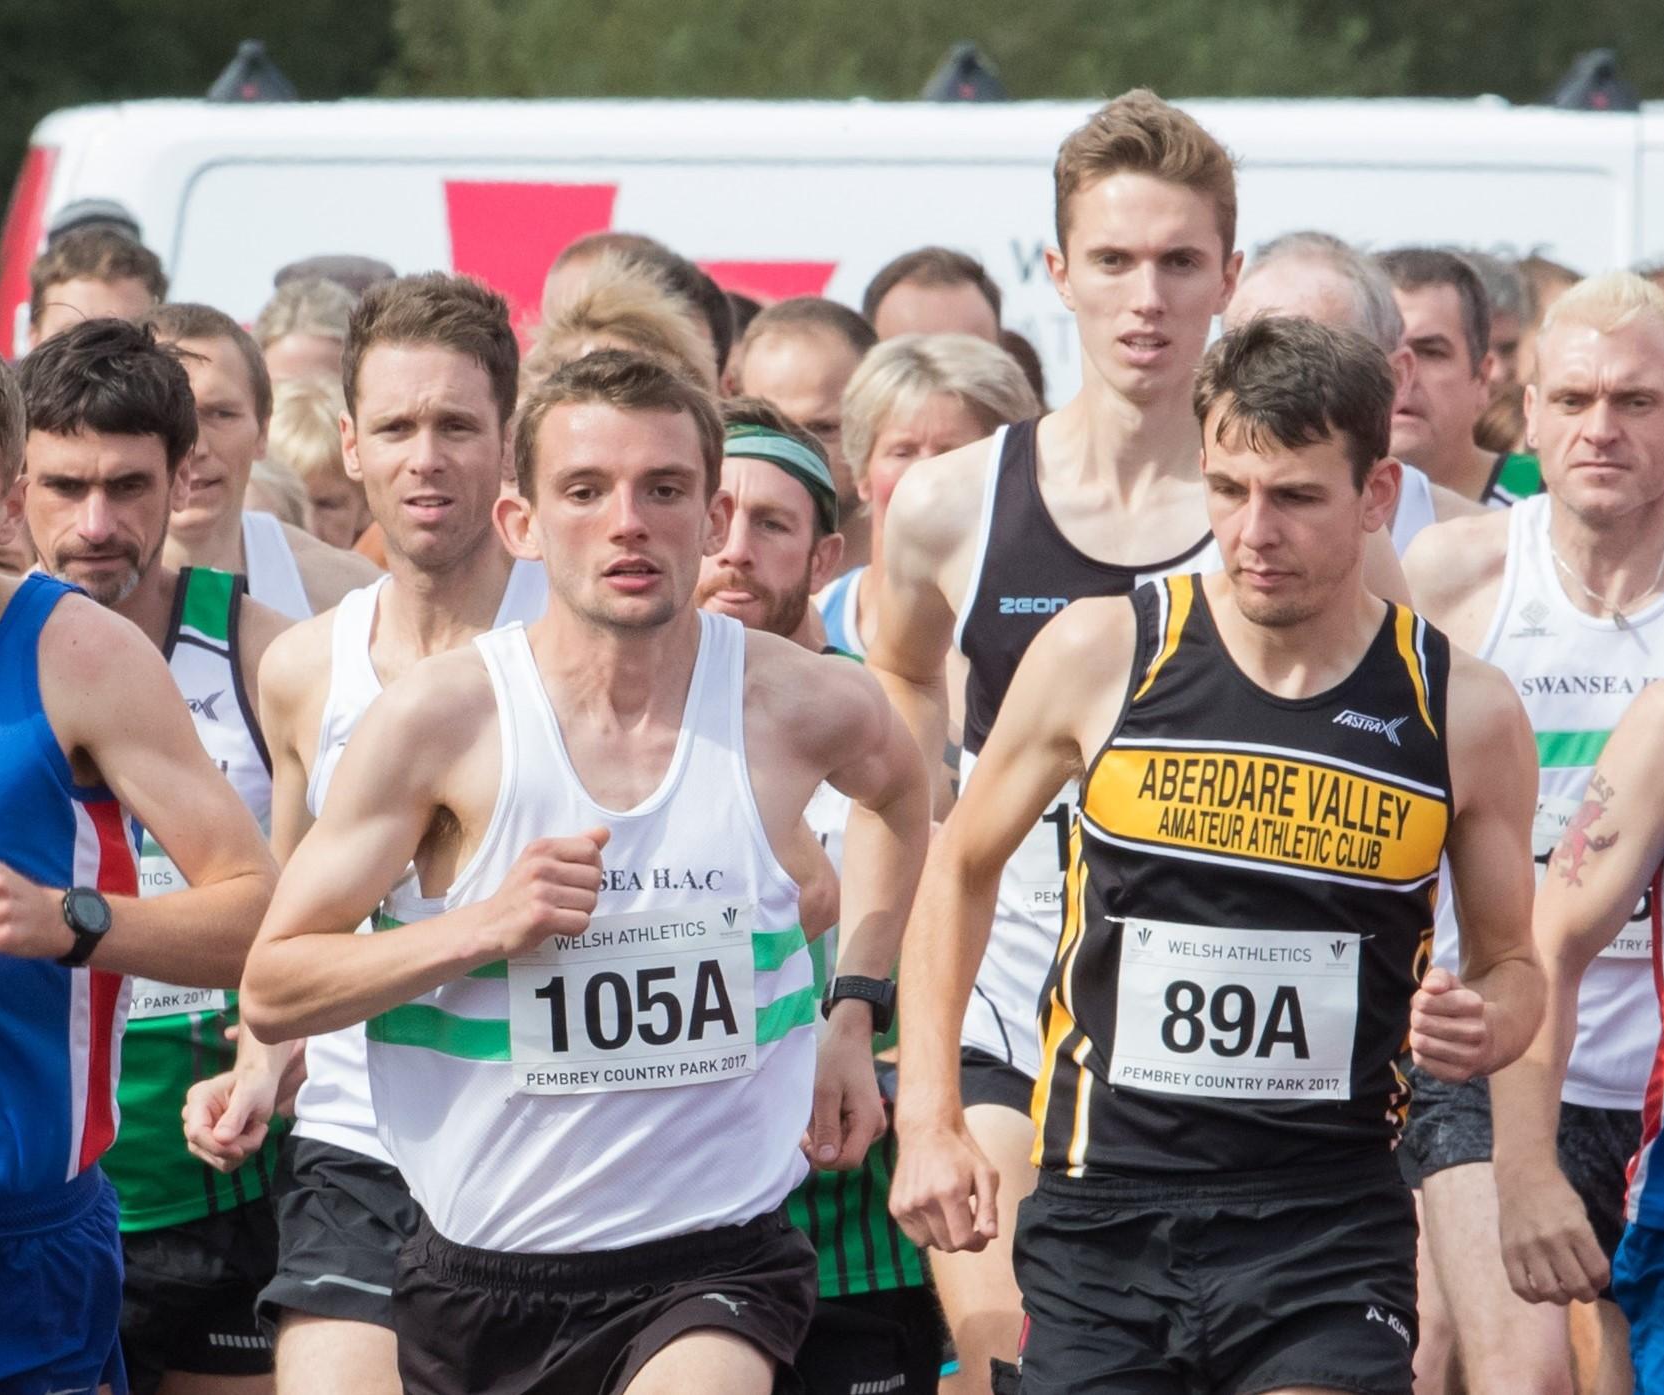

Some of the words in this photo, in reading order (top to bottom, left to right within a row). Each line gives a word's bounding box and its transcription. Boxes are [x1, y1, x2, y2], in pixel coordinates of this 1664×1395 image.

[1521, 676, 1633, 696] SWANSEA
[1138, 758, 1299, 818] ABERDARE
[1307, 770, 1411, 841] VALLEY
[1158, 807, 1244, 847] AMATEUR
[1246, 818, 1331, 864] ATHLETIC
[1335, 837, 1382, 870] CLUB
[554, 931, 613, 951] WELSH
[618, 921, 706, 945] ATHLETICS
[1168, 940, 1223, 959] WELSH
[1227, 946, 1312, 963] ATHLETICS
[144, 995, 179, 1009] PARK
[183, 989, 213, 1004] 2017
[535, 959, 738, 1053] 105A
[1161, 980, 1310, 1061] 89A
[527, 1071, 599, 1086] PEMBREY
[604, 1064, 676, 1082] COUNTRY
[680, 1059, 718, 1077] PARK
[721, 1054, 747, 1071] 2017
[1123, 1066, 1192, 1086] PEMBREY
[1195, 1075, 1263, 1091] COUNTRY
[1267, 1078, 1305, 1091] PARK
[1309, 1077, 1339, 1091] 2017
